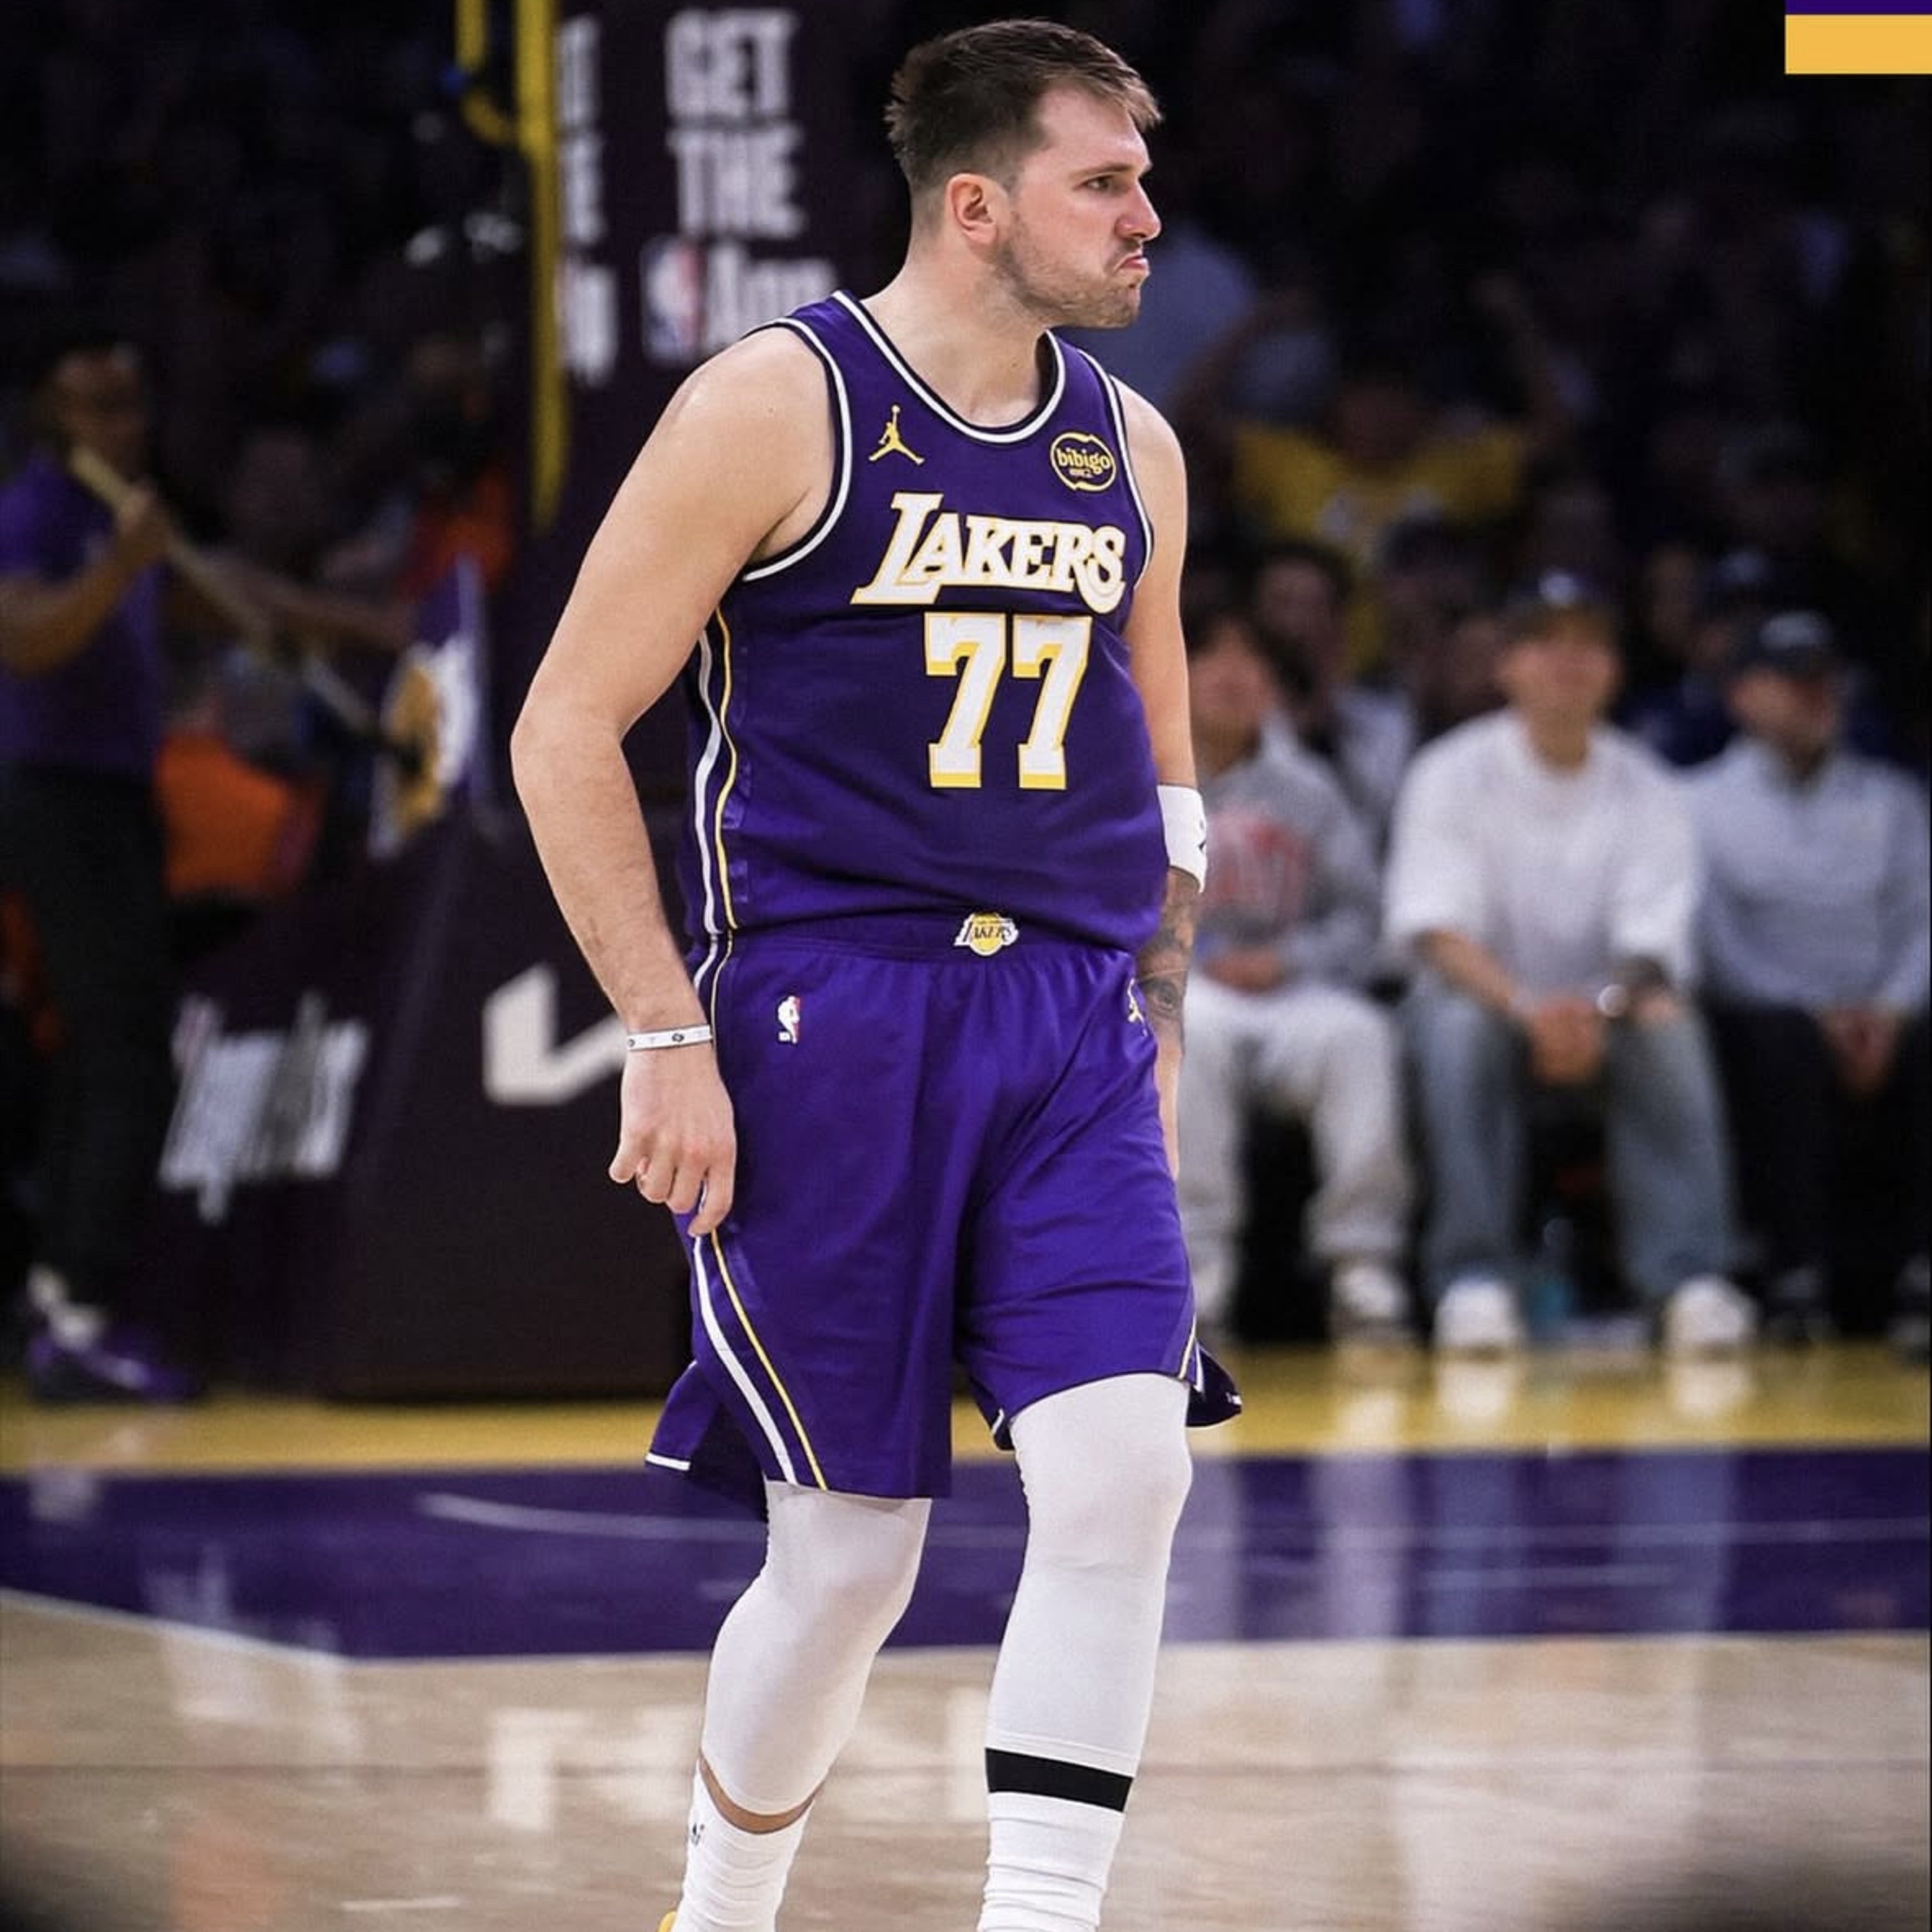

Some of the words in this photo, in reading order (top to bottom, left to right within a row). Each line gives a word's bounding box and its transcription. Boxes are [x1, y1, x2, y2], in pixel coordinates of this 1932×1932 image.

[665, 9, 795, 120] GET
[668, 128, 805, 237] THE
[1057, 448, 1110, 475] bibigo
[850, 492, 1126, 614] LAKERS
[923, 611, 1093, 790] 77
